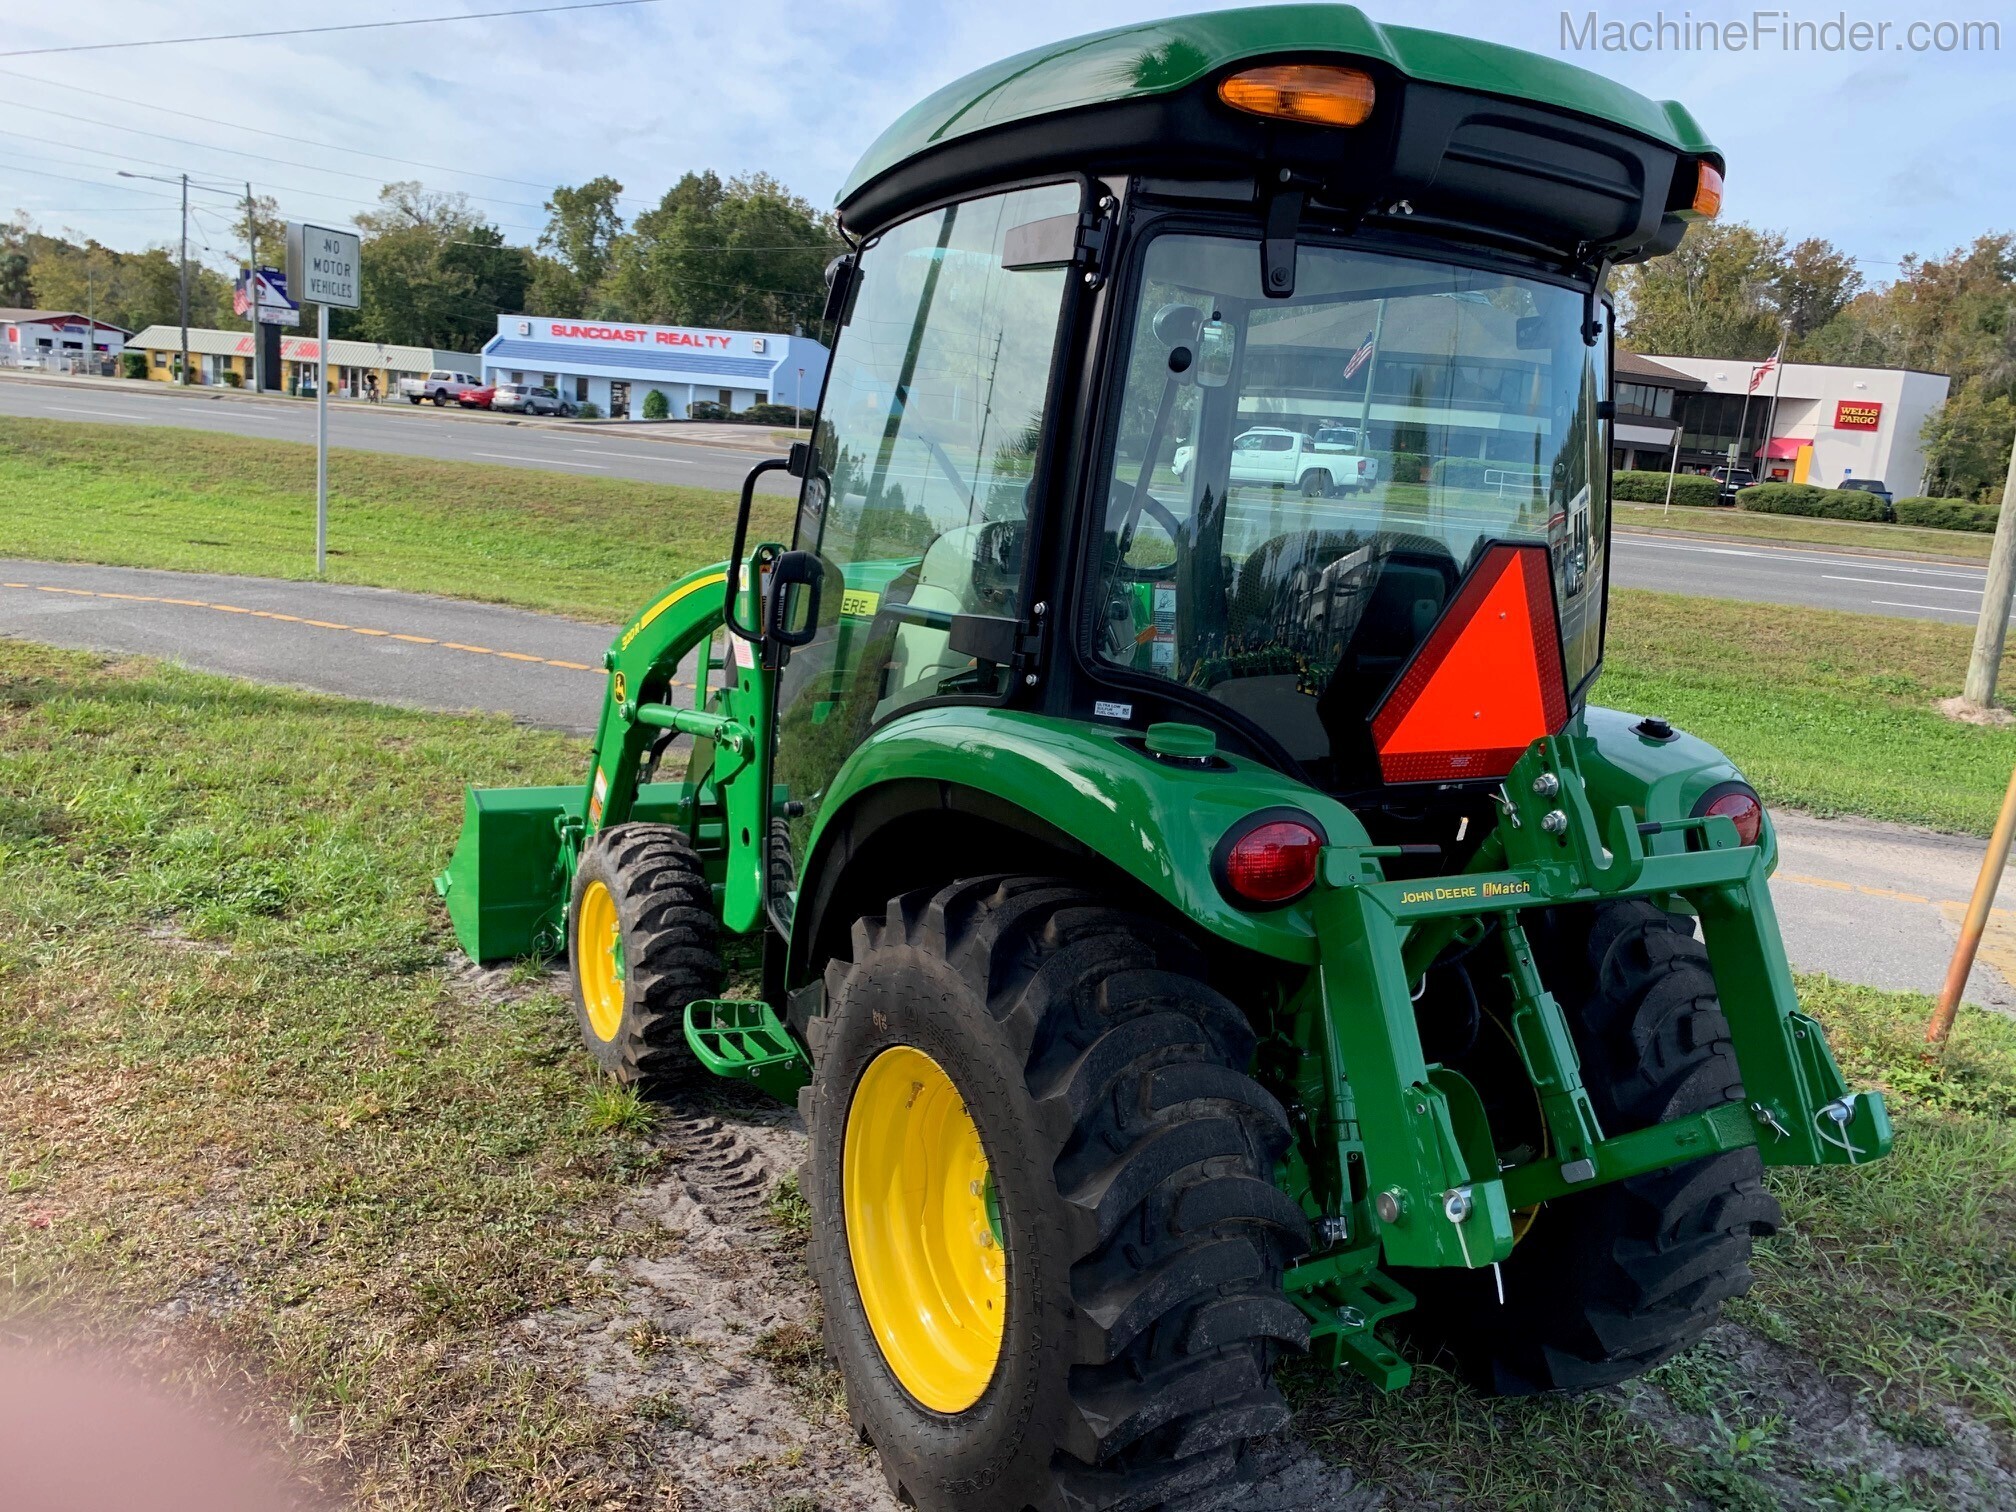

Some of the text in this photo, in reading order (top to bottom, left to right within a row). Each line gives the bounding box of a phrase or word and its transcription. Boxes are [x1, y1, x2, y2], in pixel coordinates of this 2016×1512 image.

[324, 240, 340, 254] NO
[314, 258, 351, 277] MOTOR
[311, 278, 352, 298] VEHICLES
[551, 325, 731, 349] SUNCOAST REALTY
[1839, 415, 1876, 424] FARGO
[1841, 407, 1878, 417] WELLS
[843, 598, 868, 614] ERE
[1401, 882, 1530, 904] JOHN DEERE iMatch
